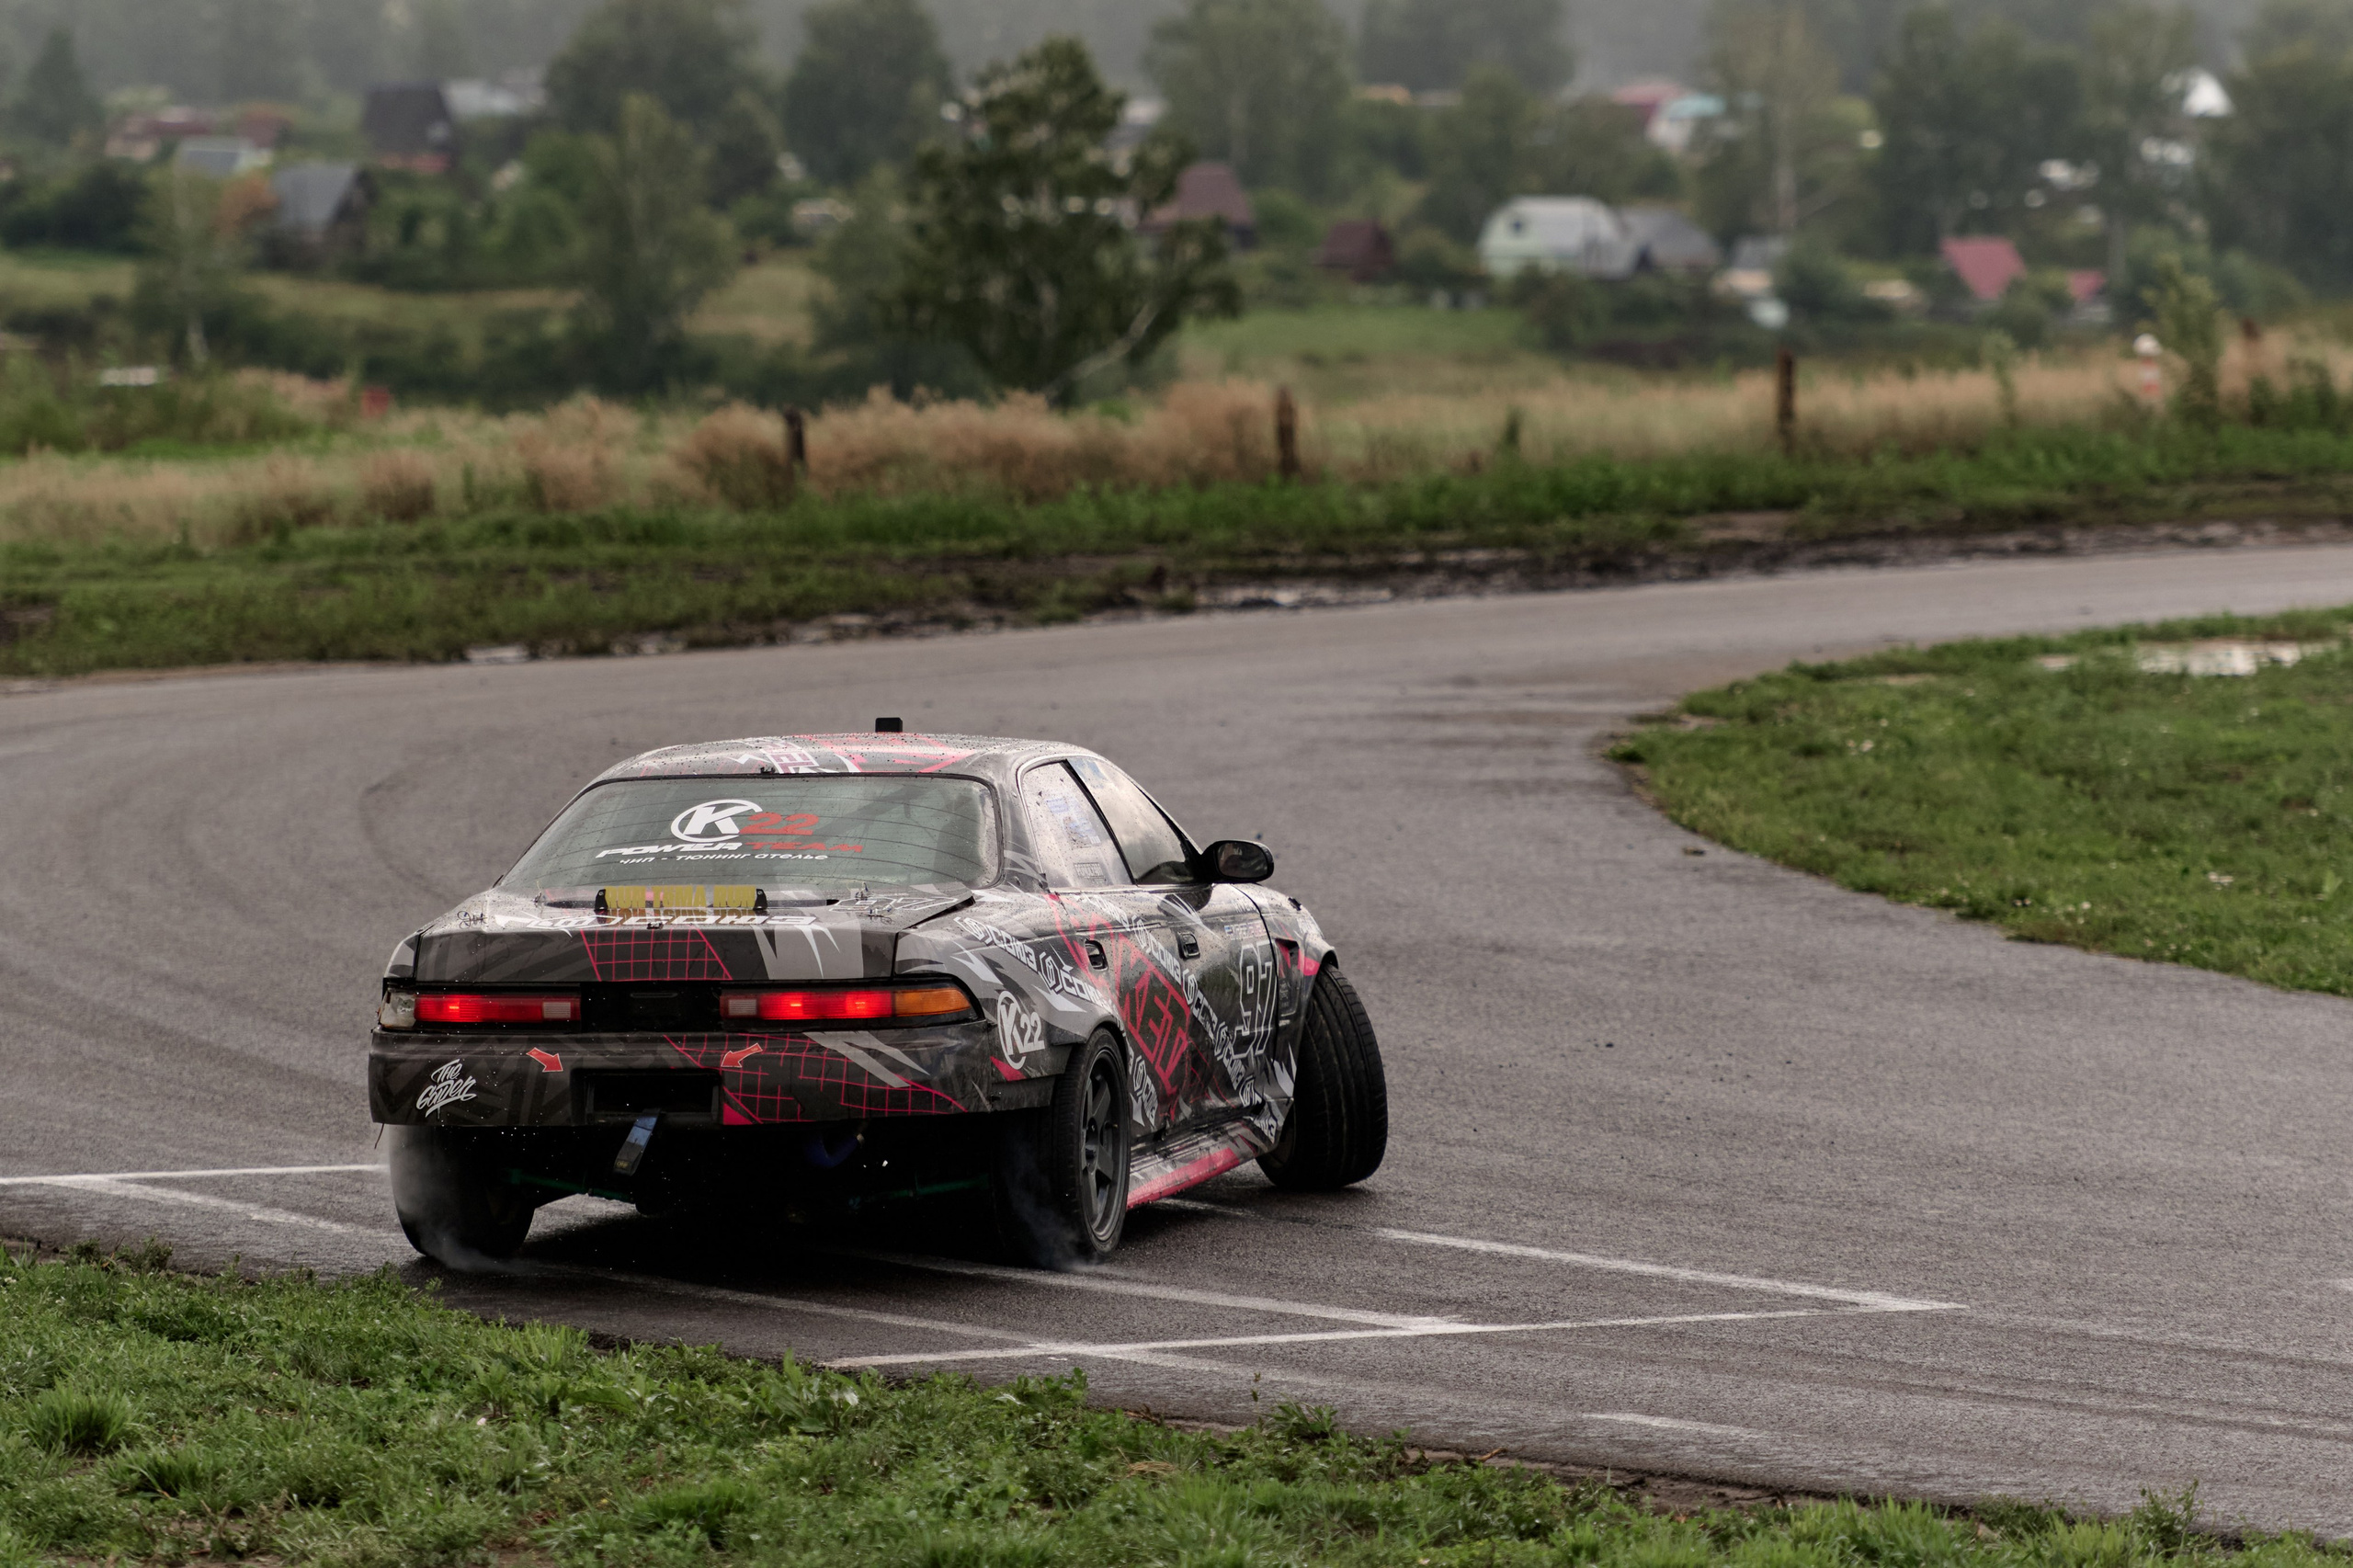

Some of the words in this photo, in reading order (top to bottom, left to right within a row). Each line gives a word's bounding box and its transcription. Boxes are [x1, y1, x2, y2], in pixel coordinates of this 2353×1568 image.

[596, 842, 743, 858] POWER
[745, 842, 864, 853] TEAM
[605, 885, 646, 907] RUN
[713, 885, 756, 908] RUN
[1232, 939, 1279, 1059] 97
